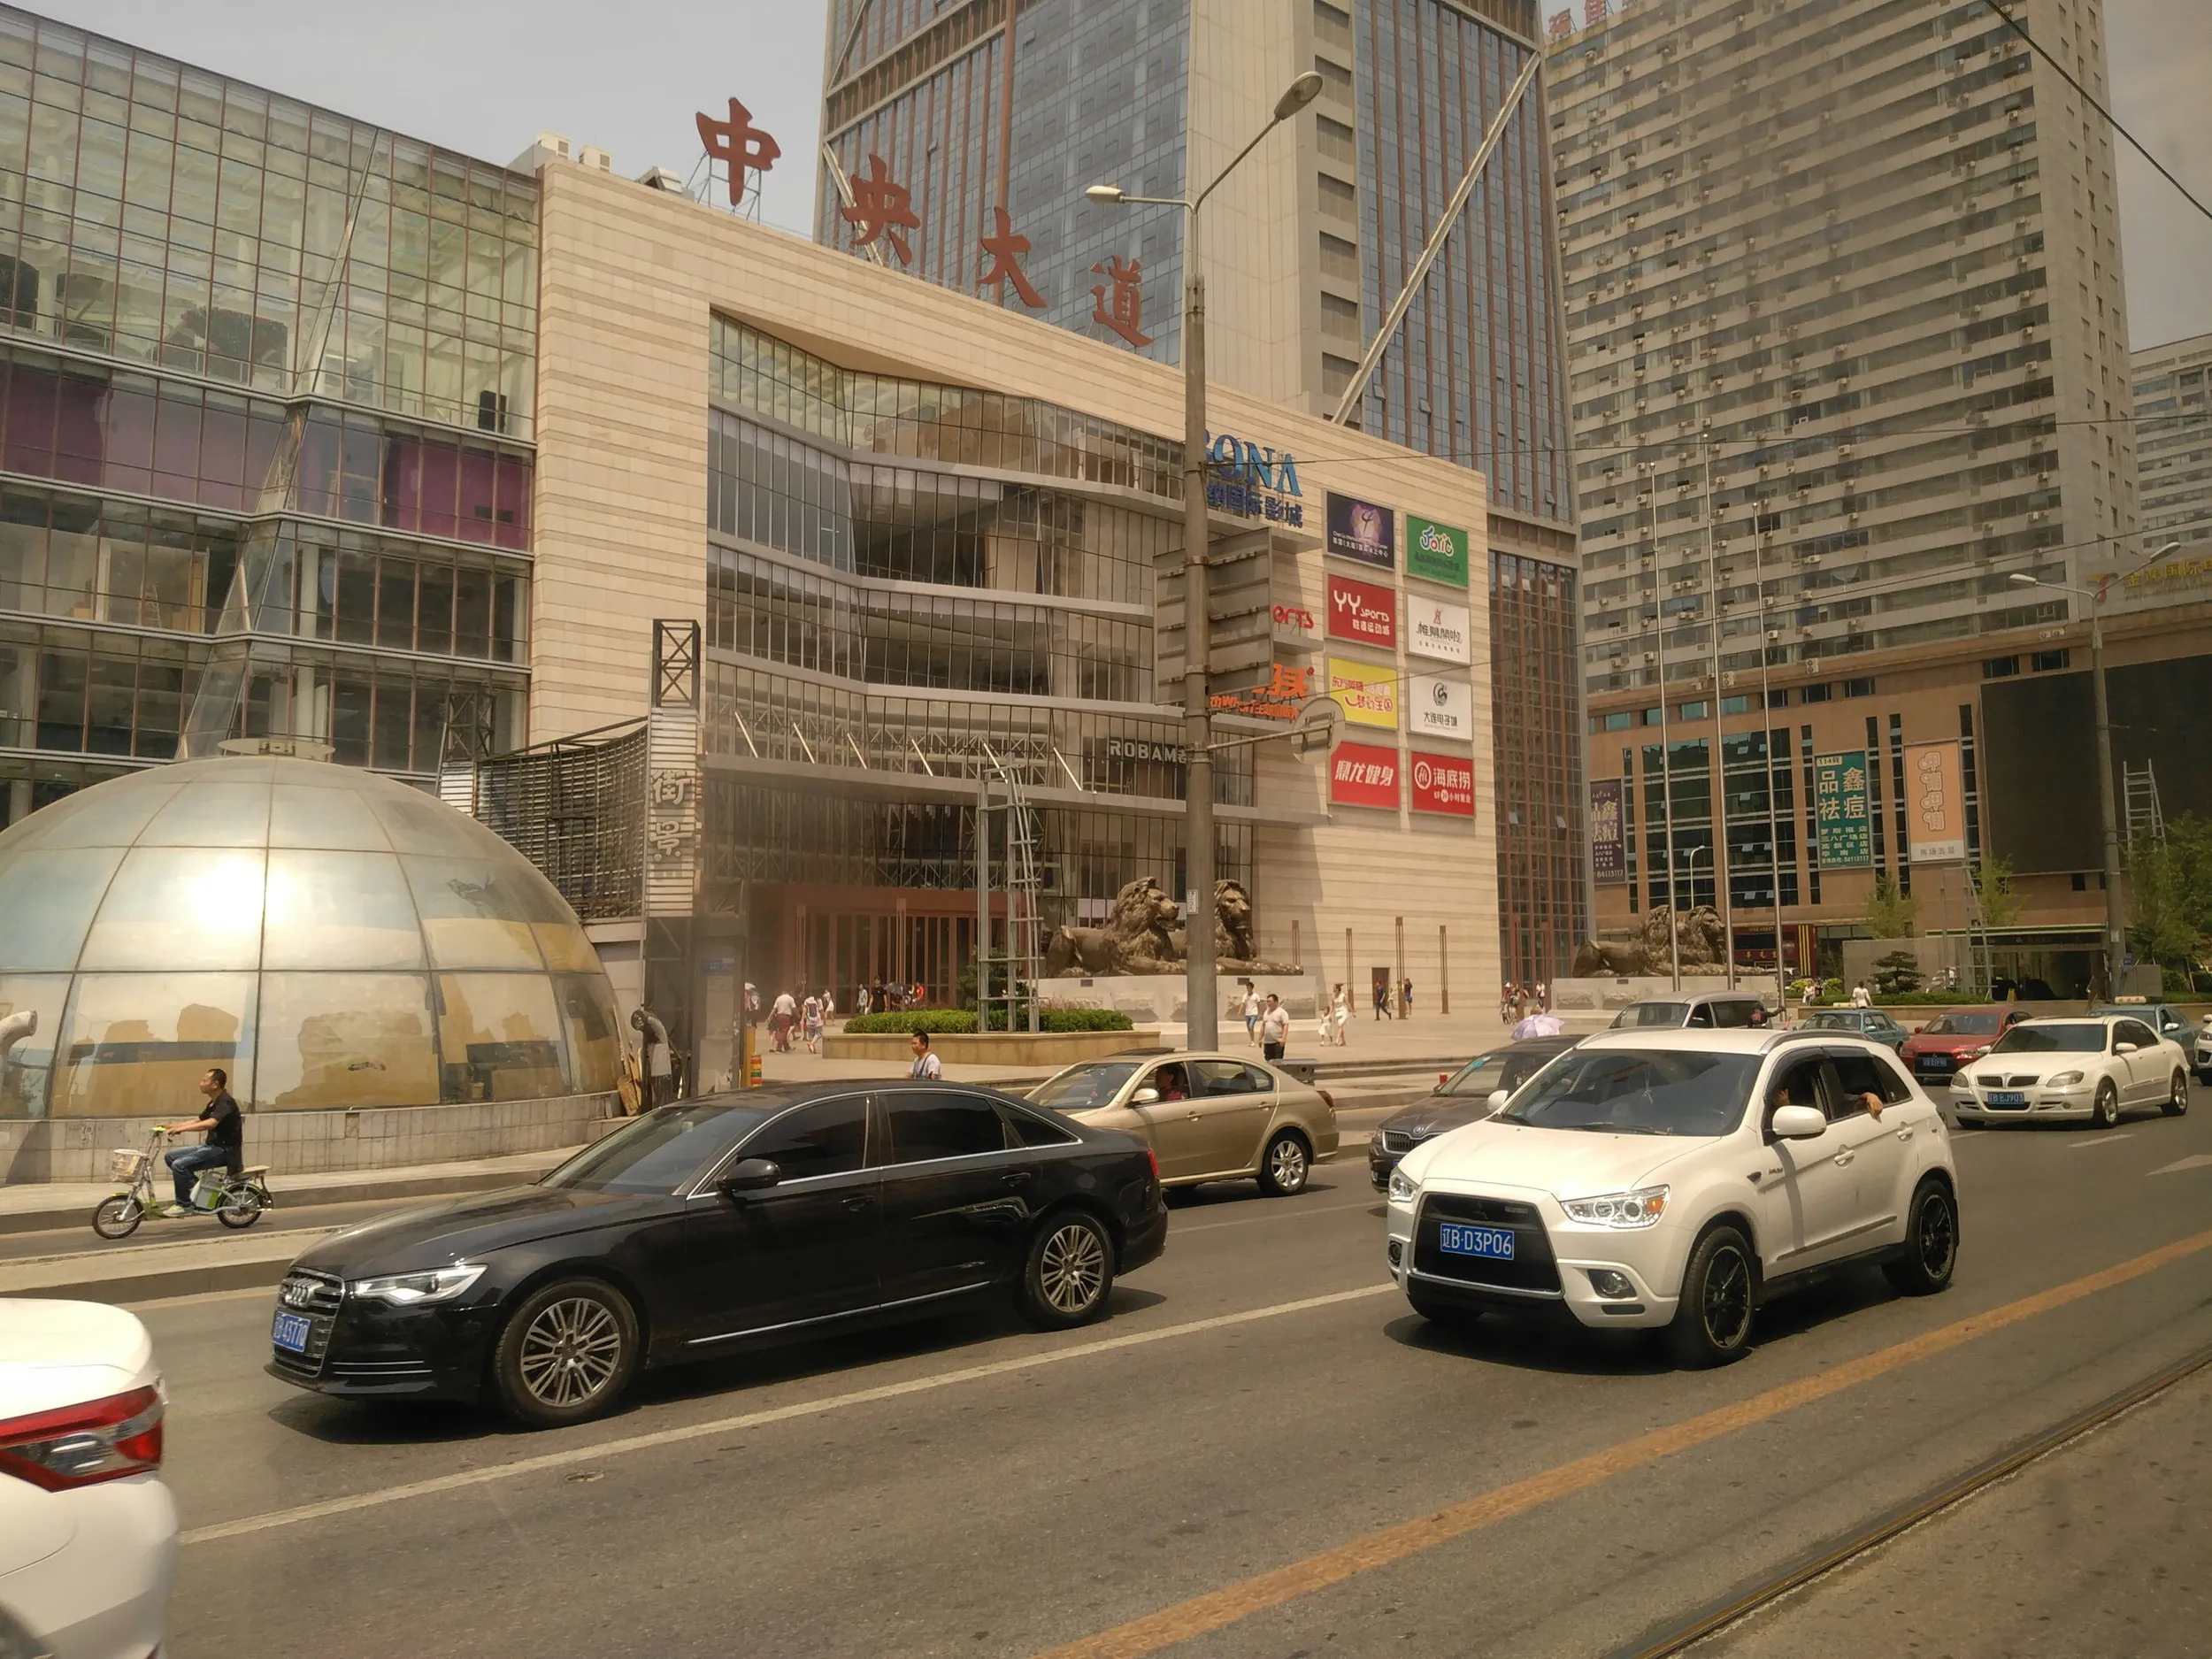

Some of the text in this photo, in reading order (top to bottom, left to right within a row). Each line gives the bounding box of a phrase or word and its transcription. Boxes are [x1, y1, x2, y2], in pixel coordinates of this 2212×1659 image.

[695, 96, 1153, 348] 中央大道
[1204, 429, 1302, 497] ONA
[1110, 740, 1177, 763] ROBAM
[1334, 760, 1394, 787] 鼎龙健身
[1433, 767, 1471, 790] 海底捞
[1818, 766, 1865, 795] 品鑫
[1818, 795, 1866, 822] 祛痘
